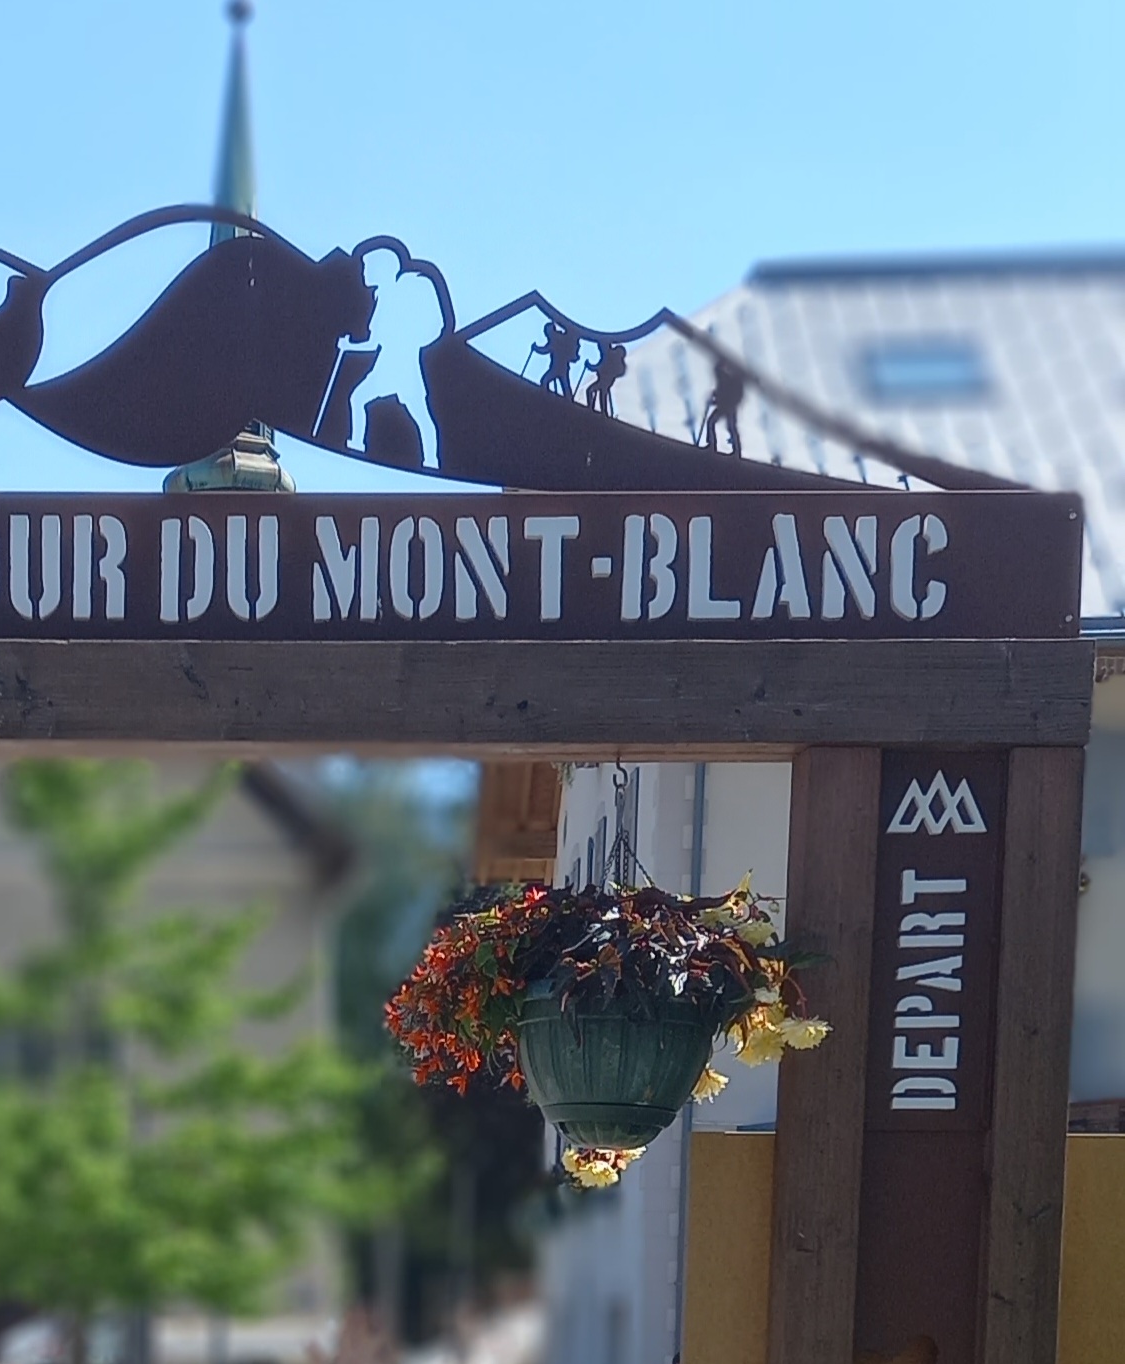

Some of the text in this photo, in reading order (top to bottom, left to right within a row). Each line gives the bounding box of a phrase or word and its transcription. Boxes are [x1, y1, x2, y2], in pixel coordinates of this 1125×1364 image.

[159, 515, 279, 623] DU
[311, 511, 949, 623] MONT-BLANC
[890, 868, 967, 1110] DEPART
